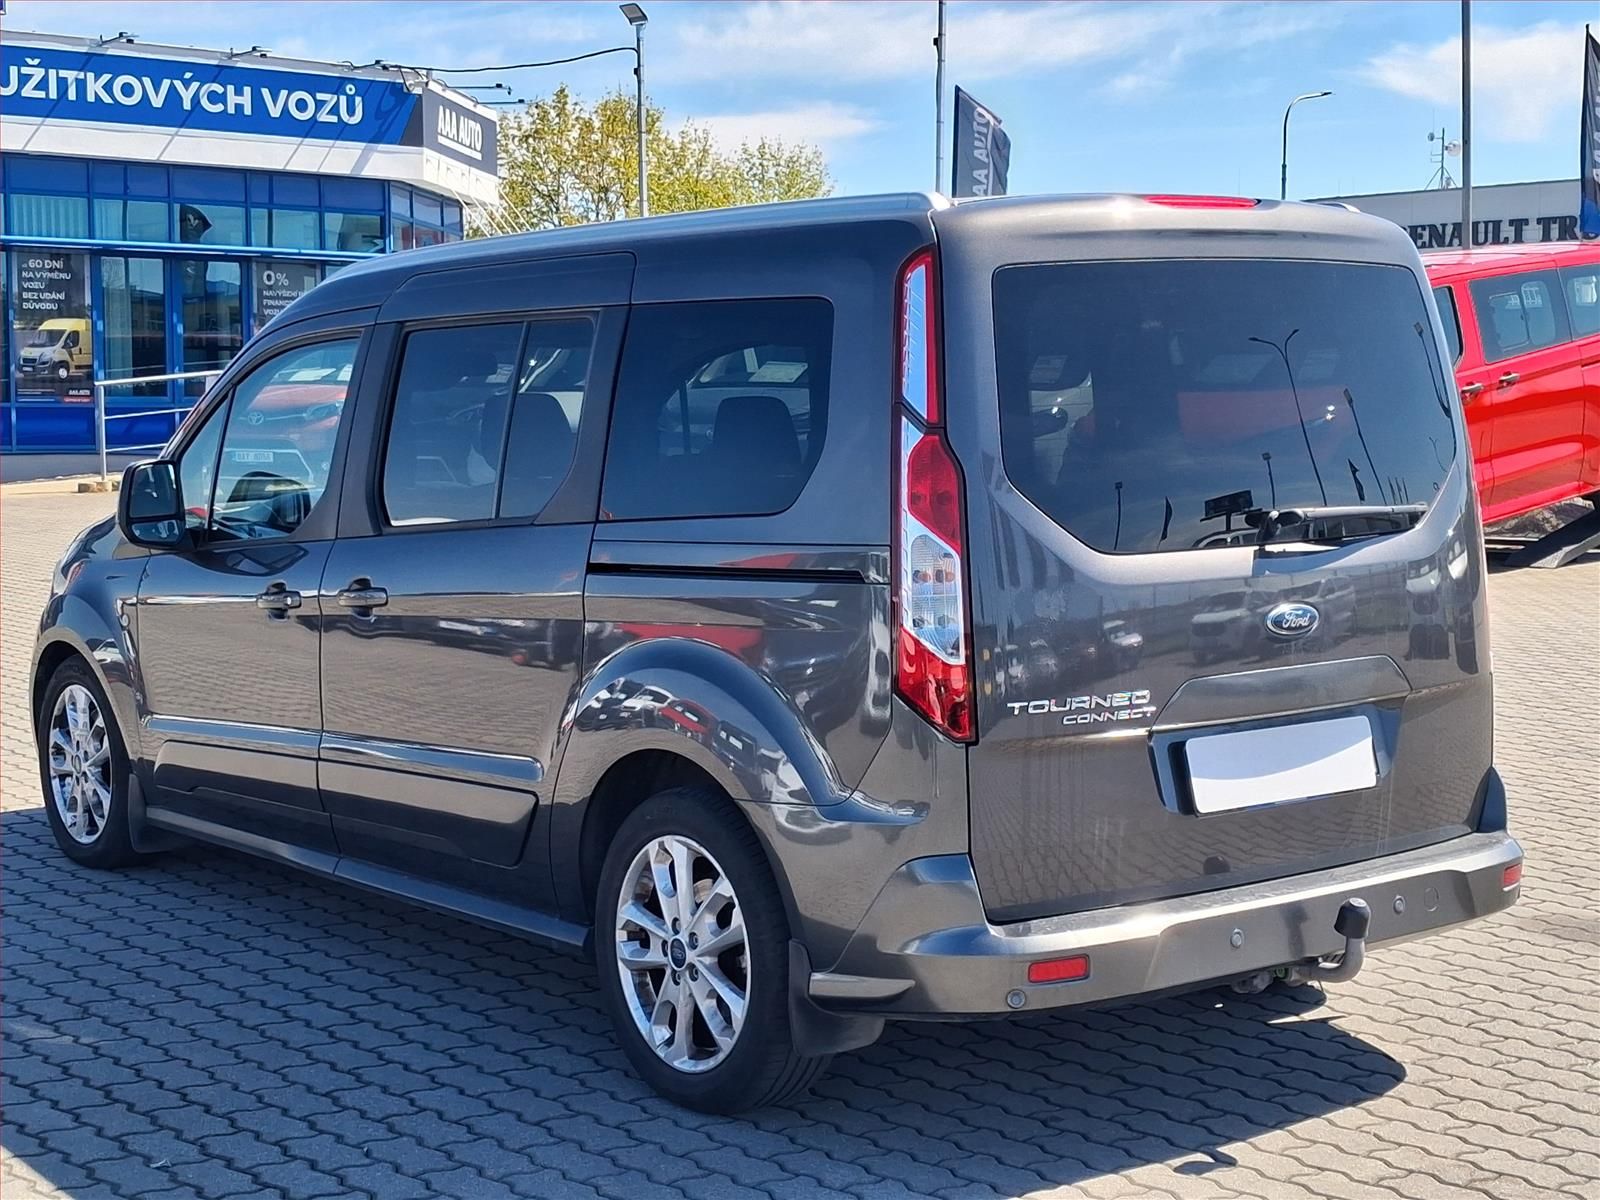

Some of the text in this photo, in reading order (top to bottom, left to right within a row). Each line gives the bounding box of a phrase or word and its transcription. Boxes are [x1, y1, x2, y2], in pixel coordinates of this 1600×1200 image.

[0, 57, 363, 125] UŽITKOVÝCH VOZŮ
[437, 105, 483, 152] AAA AUTO
[972, 106, 990, 163] AUTO
[1400, 218, 1529, 249] ENAULT
[28, 259, 43, 268] 60
[44, 258, 64, 269] DNÍ
[22, 281, 45, 289] VOZU
[263, 270, 289, 286] 0%
[22, 291, 65, 300] BEZ UDÁNÍ
[22, 300, 58, 310] DŮVODU
[1282, 610, 1311, 628] Ford
[1007, 689, 1151, 715] TOURNEO
[1063, 706, 1157, 725] CONNECT
